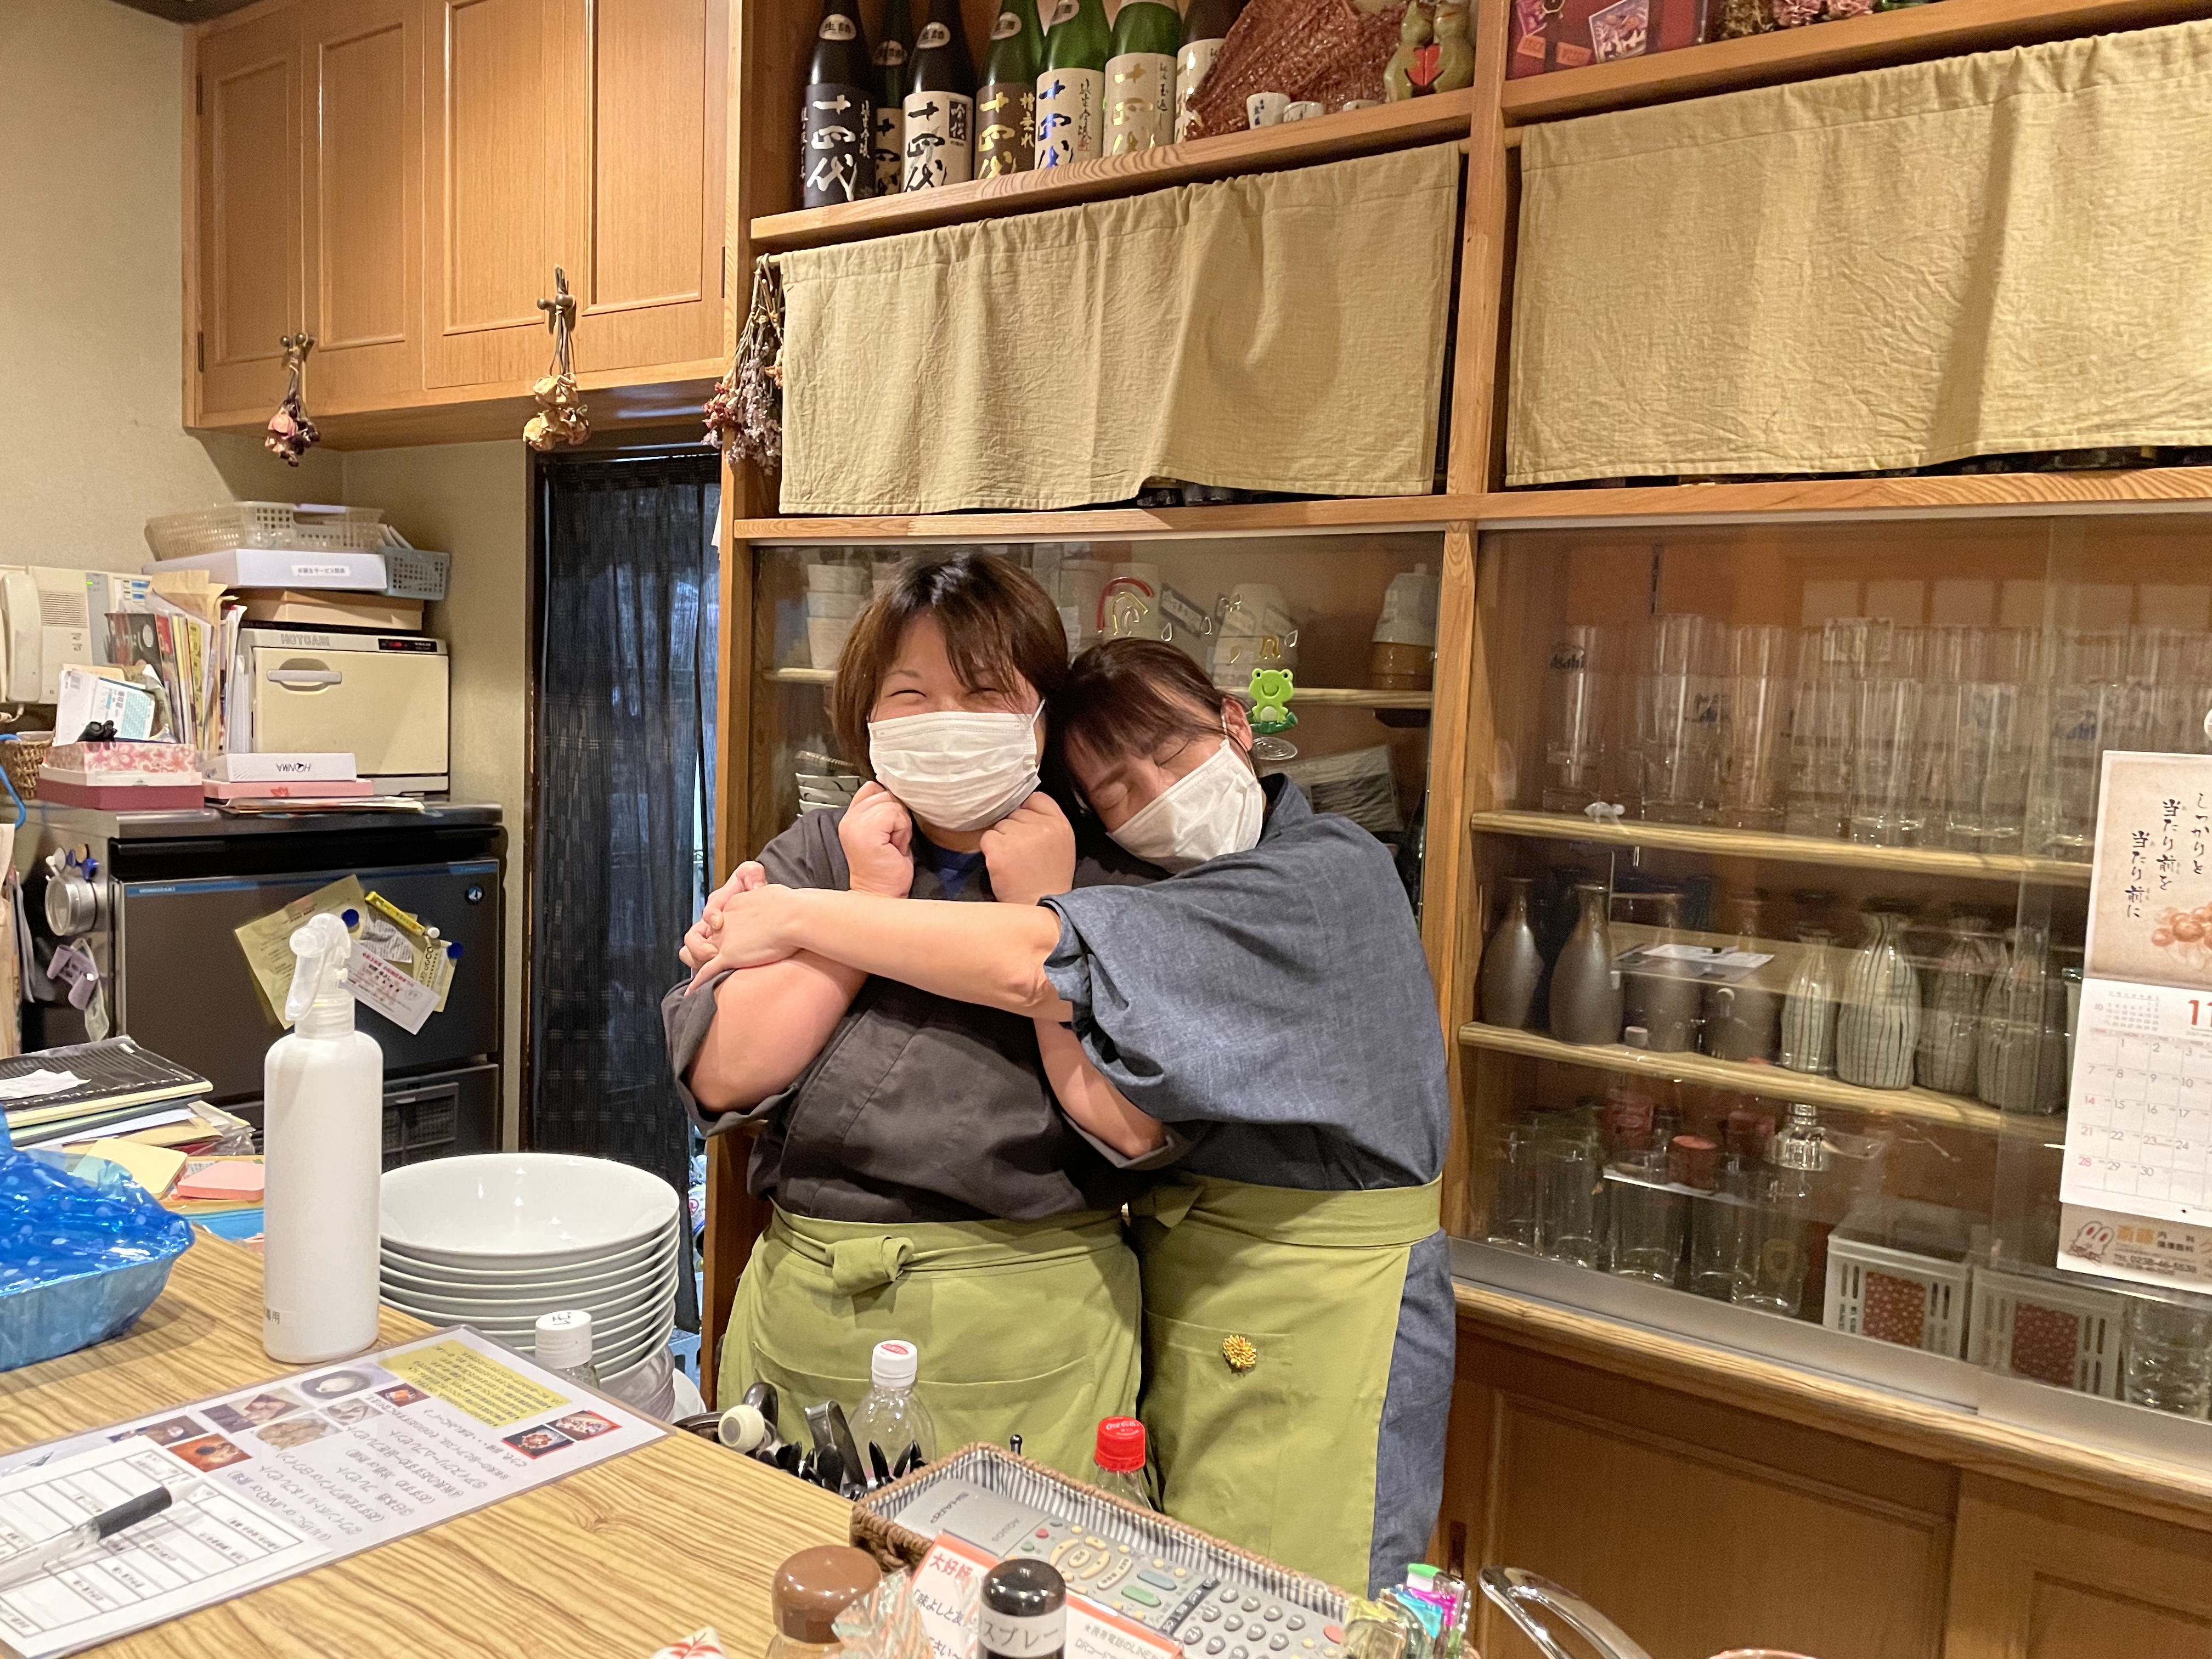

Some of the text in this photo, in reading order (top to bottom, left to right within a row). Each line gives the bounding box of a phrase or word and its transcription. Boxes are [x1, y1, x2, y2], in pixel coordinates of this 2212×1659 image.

[806, 94, 856, 202] 十四代
[906, 101, 947, 192] 十四代
[2157, 799, 2181, 890] 当たり前を
[2125, 831, 2151, 918] 当たり前に
[2153, 1042, 2160, 1053] 2
[2088, 1065, 2194, 1088] 7 8 9 10
[2085, 1095, 2191, 1119] 14 15 16 17
[2080, 1126, 2093, 1137] 21
[2110, 1131, 2124, 1141] 22
[2143, 1135, 2157, 1146] 23
[2175, 1140, 2190, 1150] 24
[2078, 1155, 2155, 1177] 28 29 30
[983, 1620, 1058, 1649] スプレー
[1187, 1628, 1200, 1639] 12
